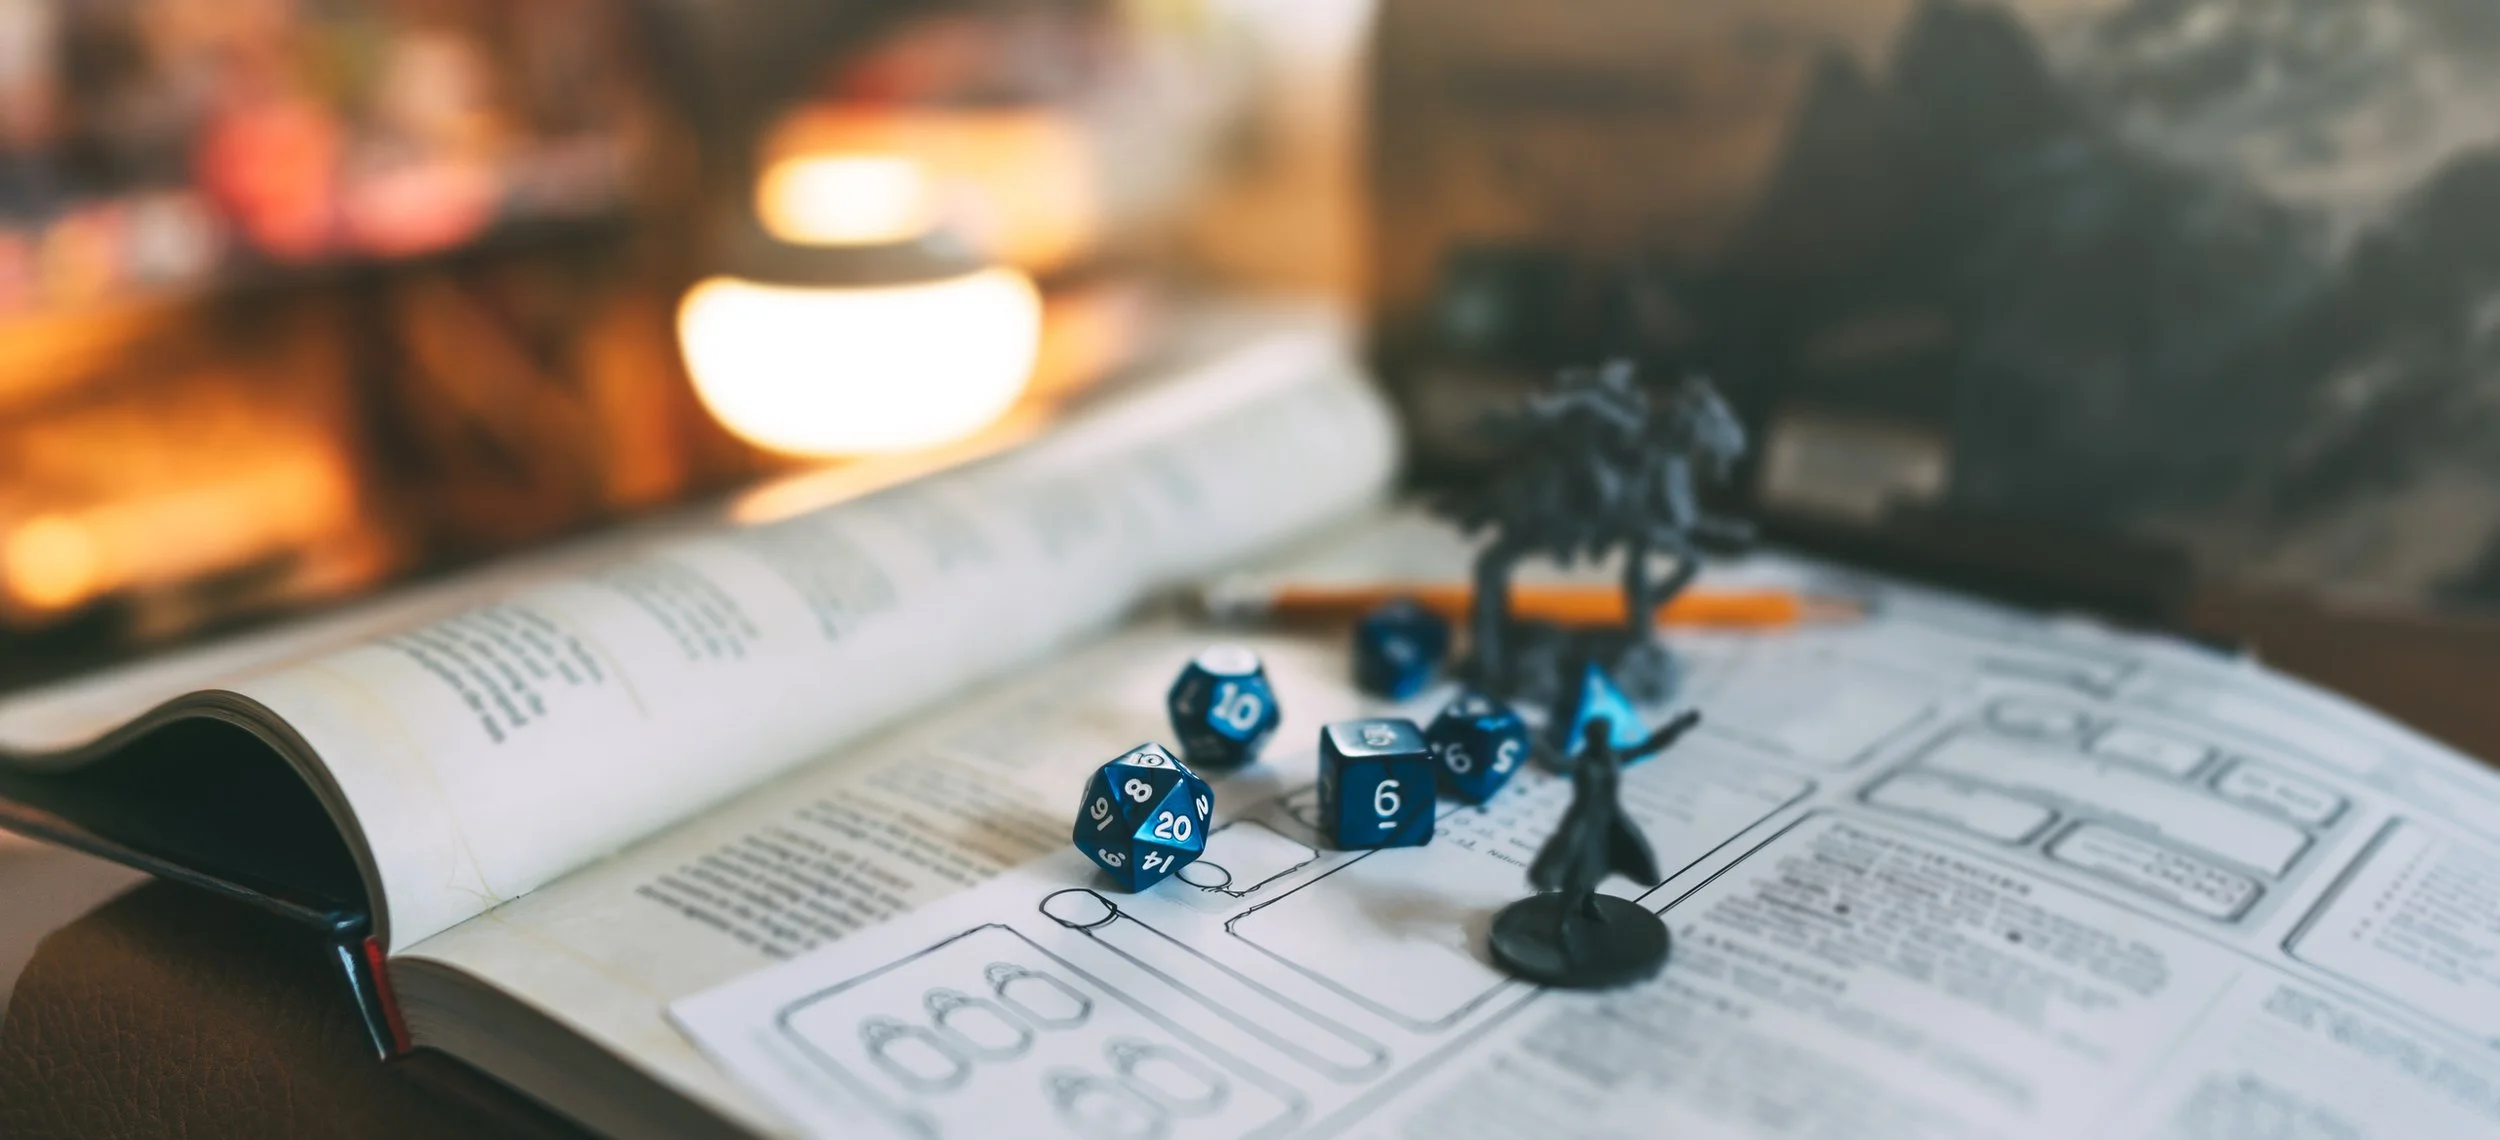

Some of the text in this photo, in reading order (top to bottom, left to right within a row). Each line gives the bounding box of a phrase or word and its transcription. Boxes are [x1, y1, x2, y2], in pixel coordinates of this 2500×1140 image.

[1212, 682, 1262, 731] 10
[1125, 778, 1153, 804] 8
[1374, 779, 1400, 829] 6
[1154, 811, 1192, 842] 20
[1141, 851, 1175, 874] 14
